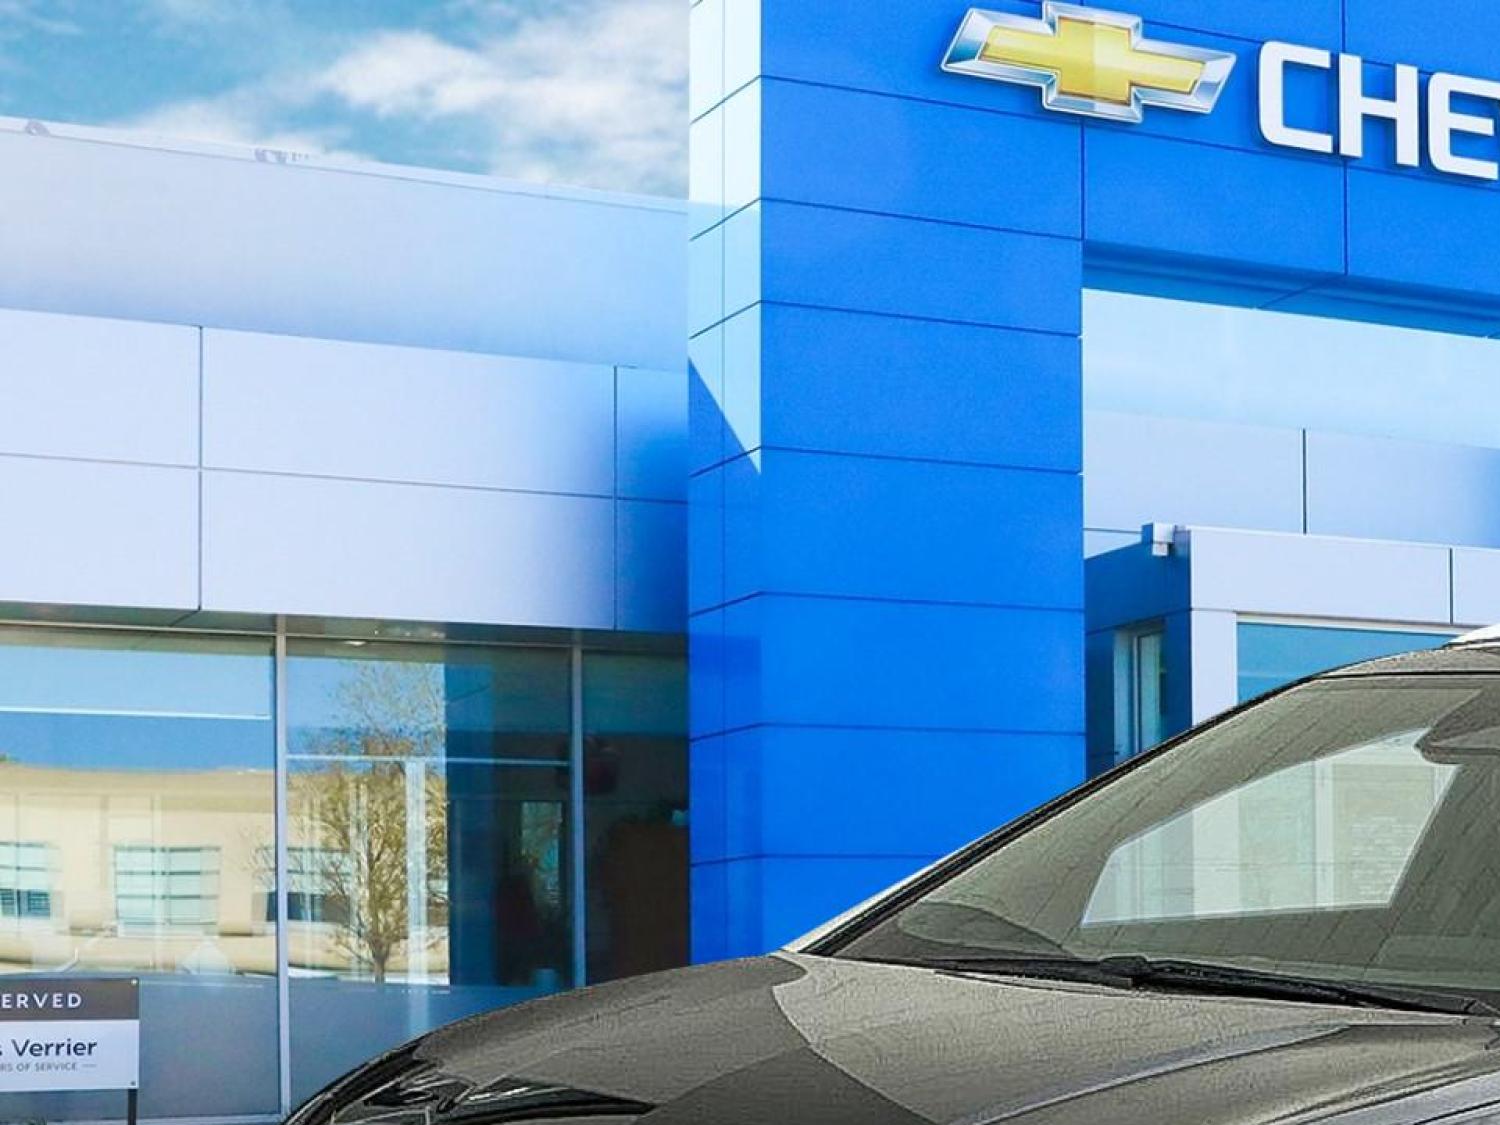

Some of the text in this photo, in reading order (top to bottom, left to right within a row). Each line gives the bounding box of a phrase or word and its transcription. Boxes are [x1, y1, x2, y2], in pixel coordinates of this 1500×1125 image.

[11, 1038, 97, 1057] Verrier
[16, 1062, 30, 1072] OF
[35, 1062, 77, 1072] SERVICE
